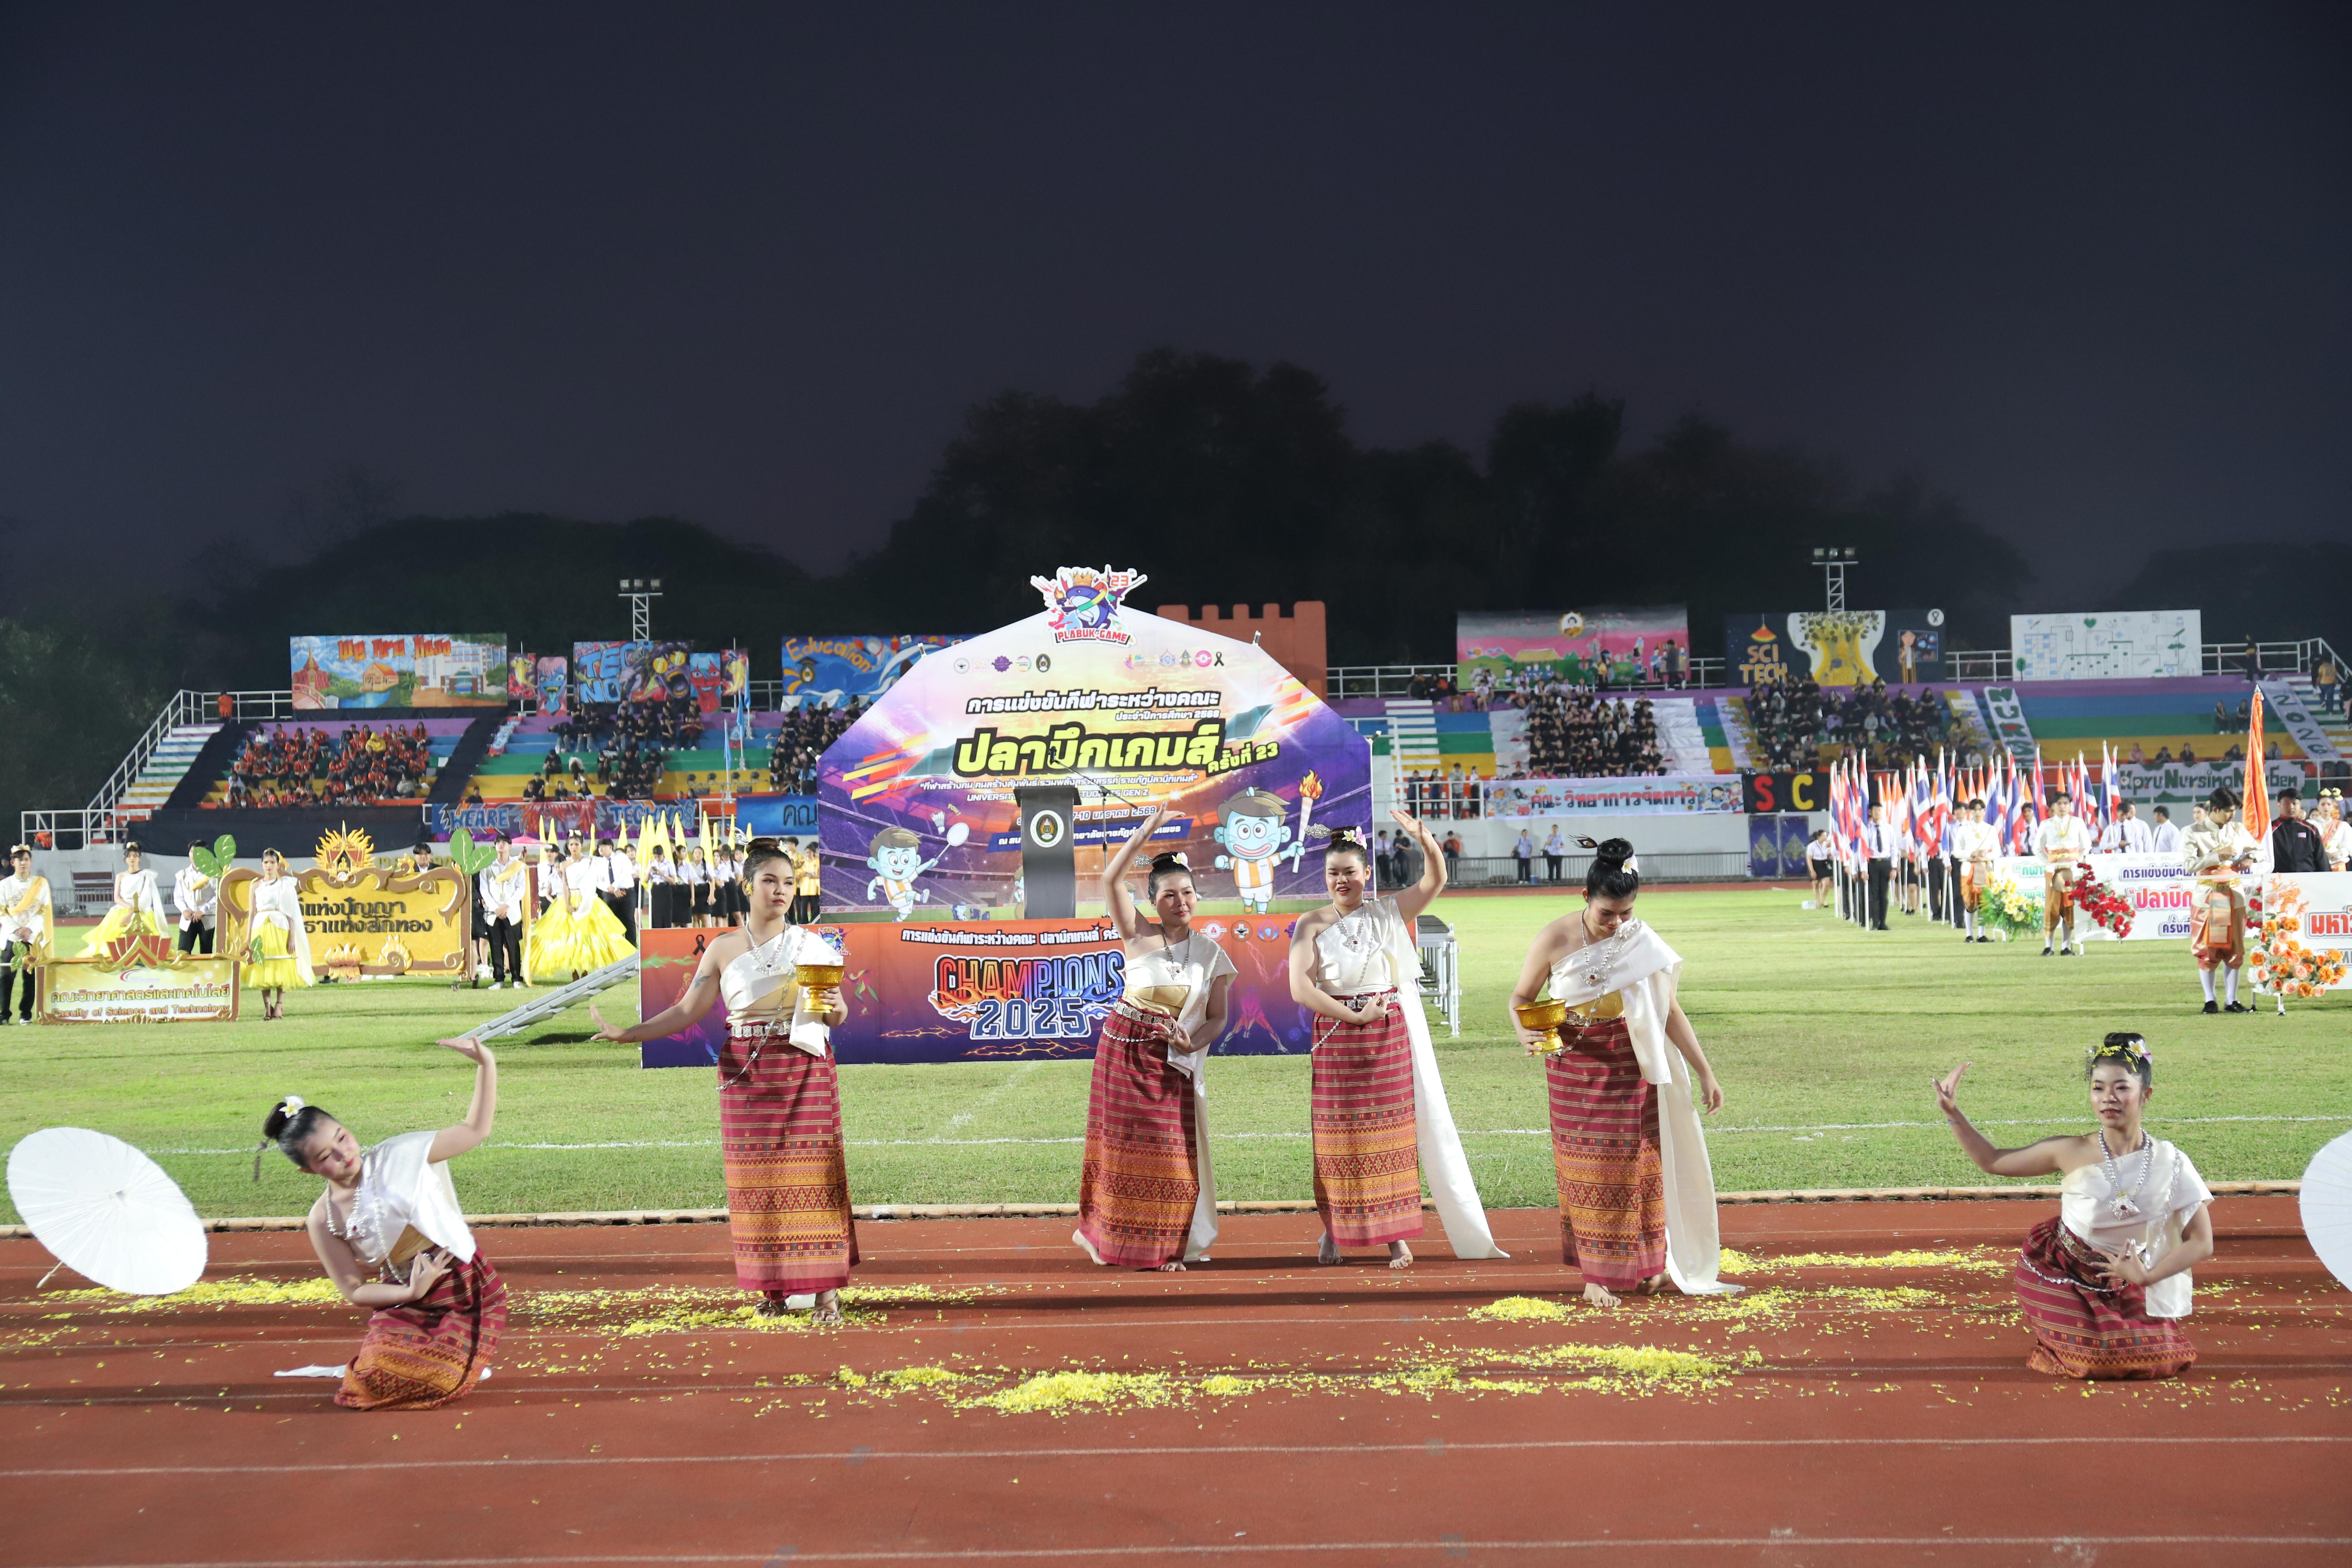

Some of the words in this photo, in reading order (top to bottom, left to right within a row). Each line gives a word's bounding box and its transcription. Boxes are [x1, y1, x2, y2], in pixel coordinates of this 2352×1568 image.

[1110, 575, 1129, 586] 23
[1099, 630, 1128, 642] GAME
[1747, 644, 1779, 663] SCI
[1739, 662, 1788, 684] TECH
[579, 678, 621, 703] NO
[967, 688, 1219, 713] การแข่งขันกีฬาระหว่างคณะ
[1116, 710, 1193, 721] ประจำปีการศึกษา
[957, 724, 1221, 772] ปลาบึกเกมส์
[1207, 743, 1252, 773] ครั้งที่
[1256, 742, 1279, 761] 23
[967, 793, 1017, 802] UNIVERSITY
[1133, 806, 1156, 816] 2569
[902, 929, 1037, 945] การแข่งขันกีฬาระหว่างคณะ
[939, 951, 1124, 1003] CHAMPIONS
[51, 984, 230, 1003] คณะวิทยาศาสตร์และเทคโนโลยี
[52, 1008, 89, 1019] Faculty
[92, 1007, 103, 1016] of
[106, 1007, 146, 1016] Science
[149, 1005, 168, 1014] and
[972, 997, 1089, 1038] 2025
